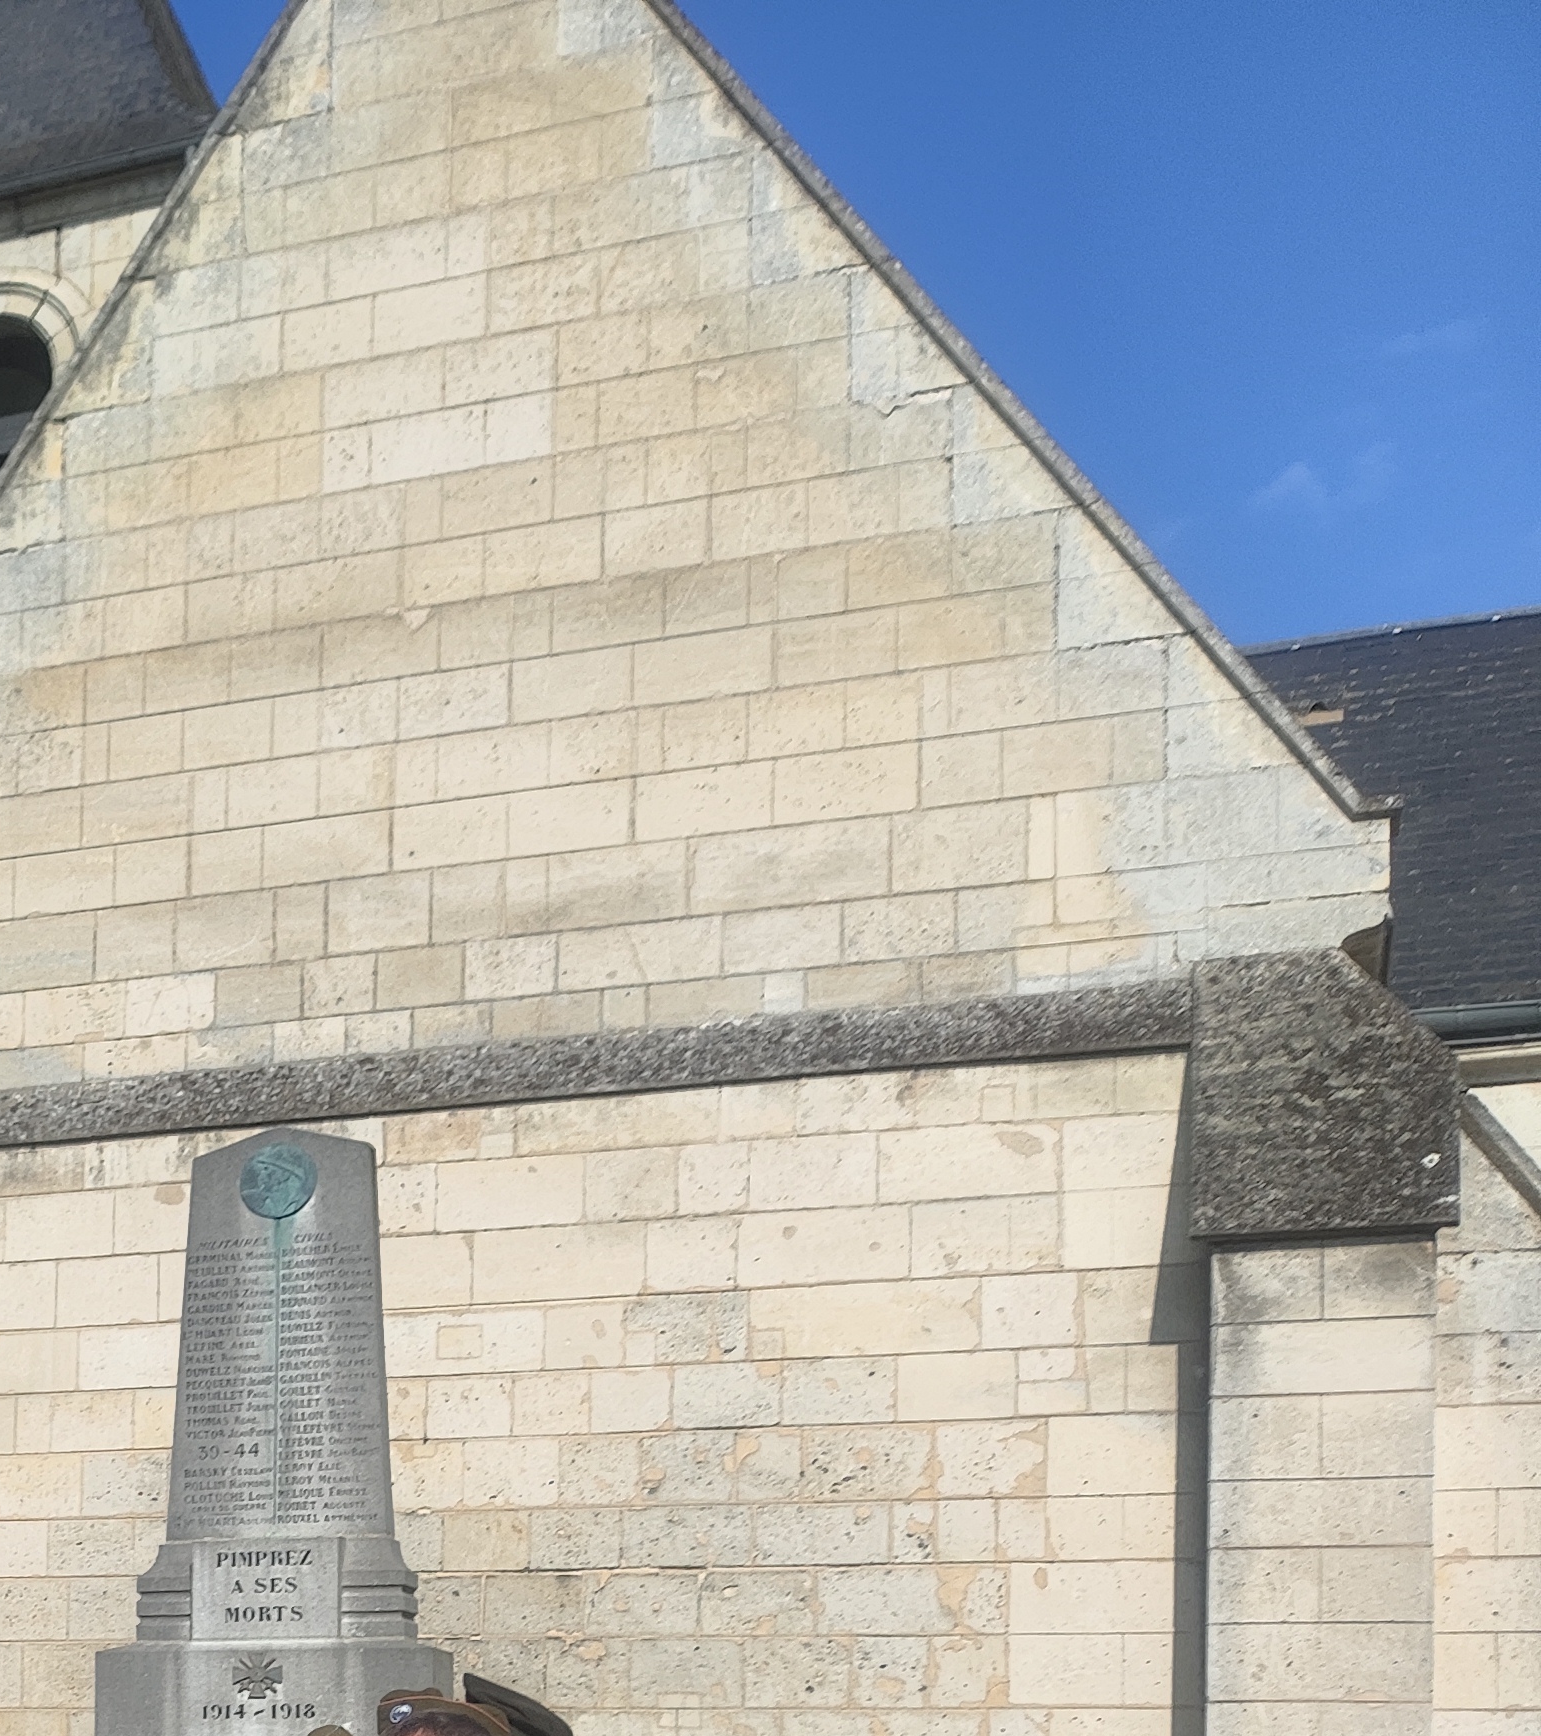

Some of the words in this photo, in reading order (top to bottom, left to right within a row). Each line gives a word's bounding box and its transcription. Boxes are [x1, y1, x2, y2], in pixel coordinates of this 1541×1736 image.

[215, 1549, 314, 1569] PIMPREZ
[231, 1578, 244, 1595] A
[254, 1576, 299, 1595] SES
[224, 1605, 304, 1624] MORTS
